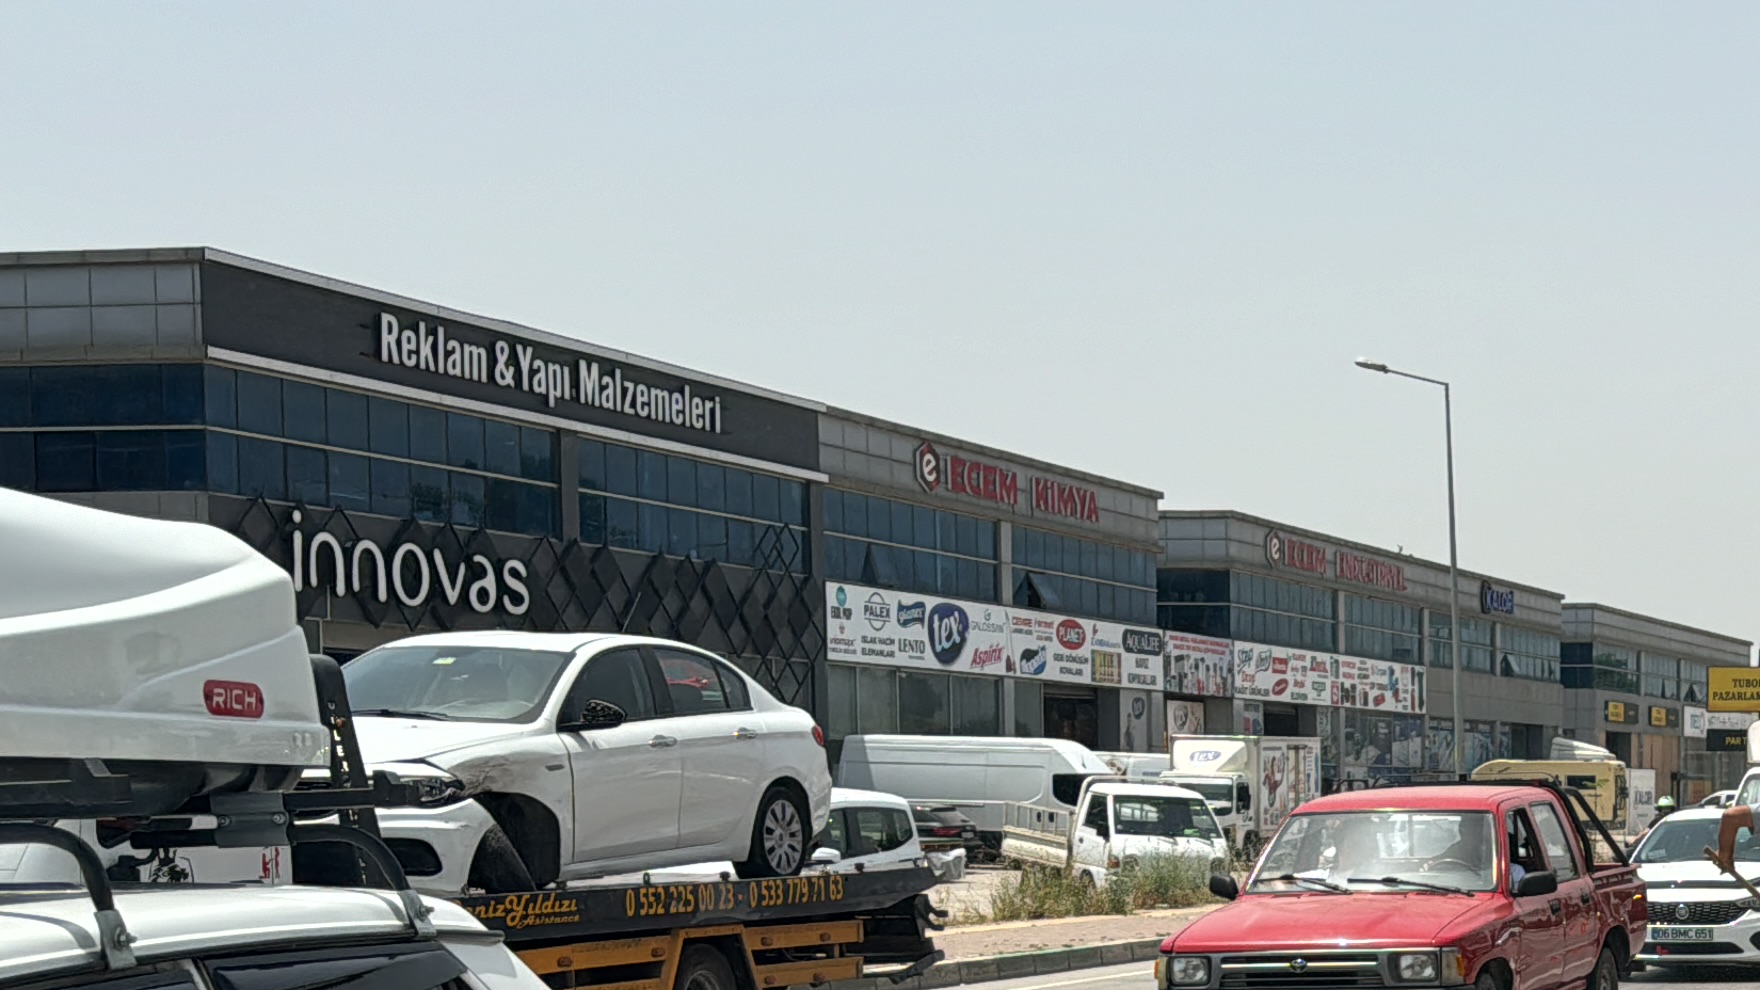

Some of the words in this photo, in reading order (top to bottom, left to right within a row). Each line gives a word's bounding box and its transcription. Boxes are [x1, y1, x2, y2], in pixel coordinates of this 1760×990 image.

[380, 312, 488, 384] Reklam
[578, 358, 722, 434] Malzemeleri
[947, 455, 1018, 505] ECEM
[1033, 476, 1099, 523] KİMYA
[292, 509, 530, 615] innovas
[864, 604, 891, 619] PALEX
[898, 638, 925, 655] LENTO
[212, 688, 257, 711] RICH
[639, 887, 666, 916] 552
[669, 885, 695, 914] 225
[699, 883, 714, 911] 00
[718, 883, 735, 910] 23
[761, 879, 784, 907] 533
[787, 877, 809, 905] 779
[813, 877, 825, 902] 71
[829, 875, 844, 901] 63
[1671, 929, 1693, 939] BMC
